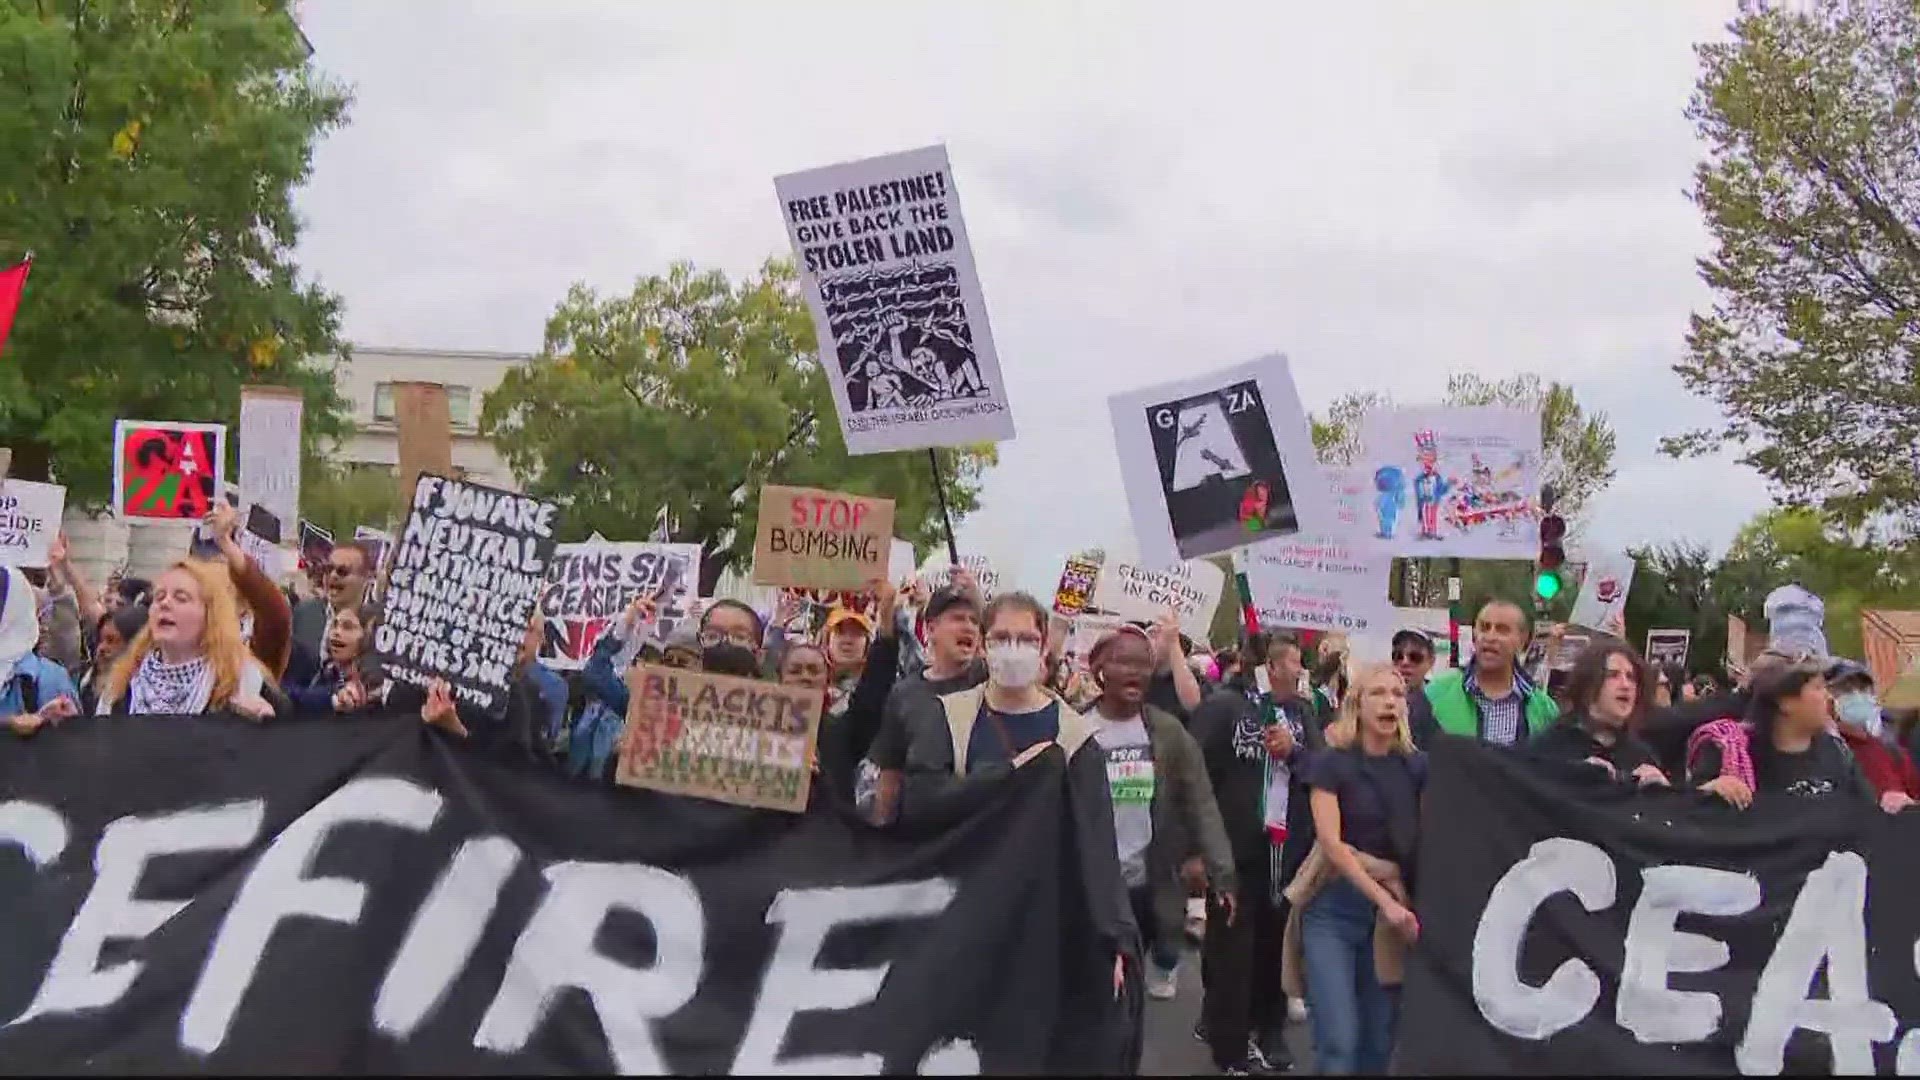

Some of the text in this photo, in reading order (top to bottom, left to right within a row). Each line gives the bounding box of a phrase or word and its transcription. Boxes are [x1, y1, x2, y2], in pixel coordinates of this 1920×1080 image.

[788, 171, 947, 223] FREE PALESTINE!
[796, 203, 948, 243] GIVE BACK THE
[804, 226, 955, 273] STOLEN LAND
[414, 476, 558, 538] IF YOU ARE
[791, 492, 870, 531] STOP
[403, 511, 543, 573] NEUTRAL
[770, 527, 879, 563] BOMBING
[1124, 582, 1143, 598] IN
[0, 777, 984, 1076] EFIRE.
[1472, 837, 1920, 1076] CEA
